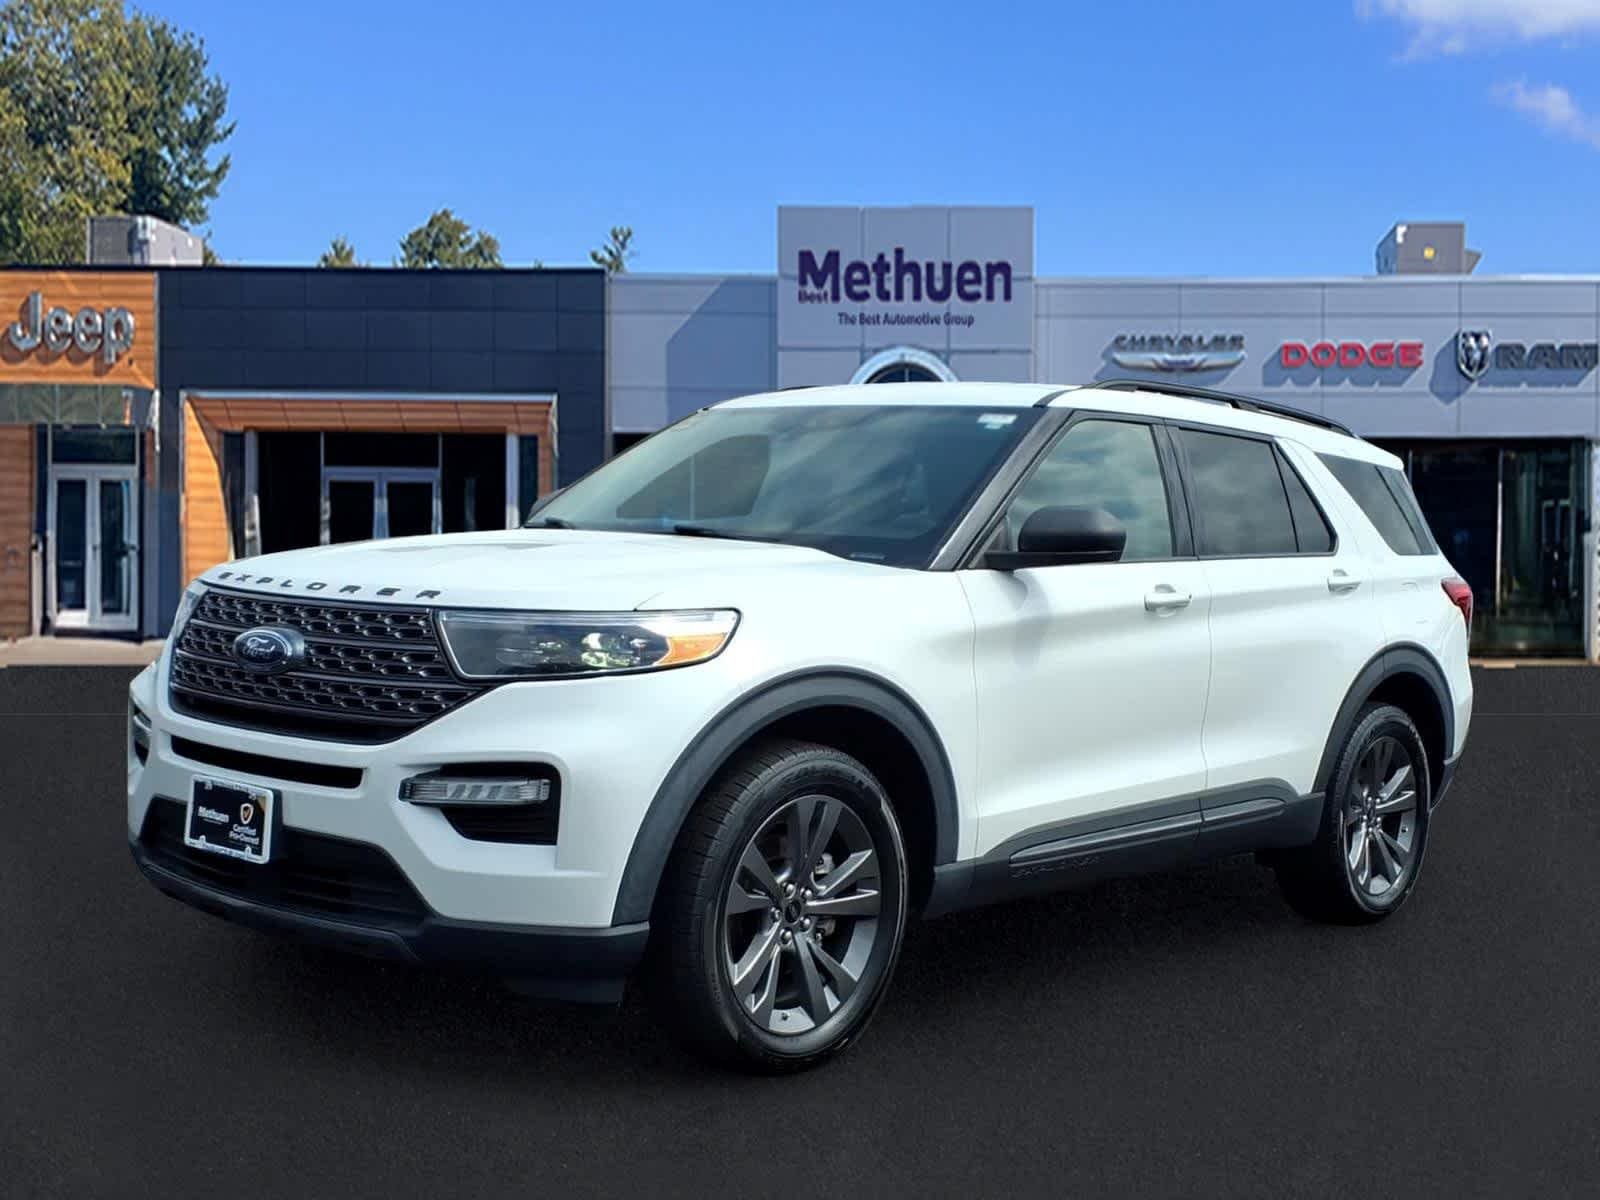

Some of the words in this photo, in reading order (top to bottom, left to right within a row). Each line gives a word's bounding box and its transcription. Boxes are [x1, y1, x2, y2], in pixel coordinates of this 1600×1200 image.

[798, 247, 1012, 302] Methuen
[798, 289, 829, 303] Best
[9, 291, 135, 363] Jeep
[838, 312, 857, 325] The
[859, 312, 881, 325] Best
[883, 312, 941, 325] Automotive
[943, 312, 975, 327] Group
[1113, 333, 1246, 349] CHRYSLER
[1281, 342, 1424, 369] DODGE
[1496, 343, 1599, 369] RAM
[218, 572, 441, 599] EXPLORER
[242, 636, 277, 657] Ford
